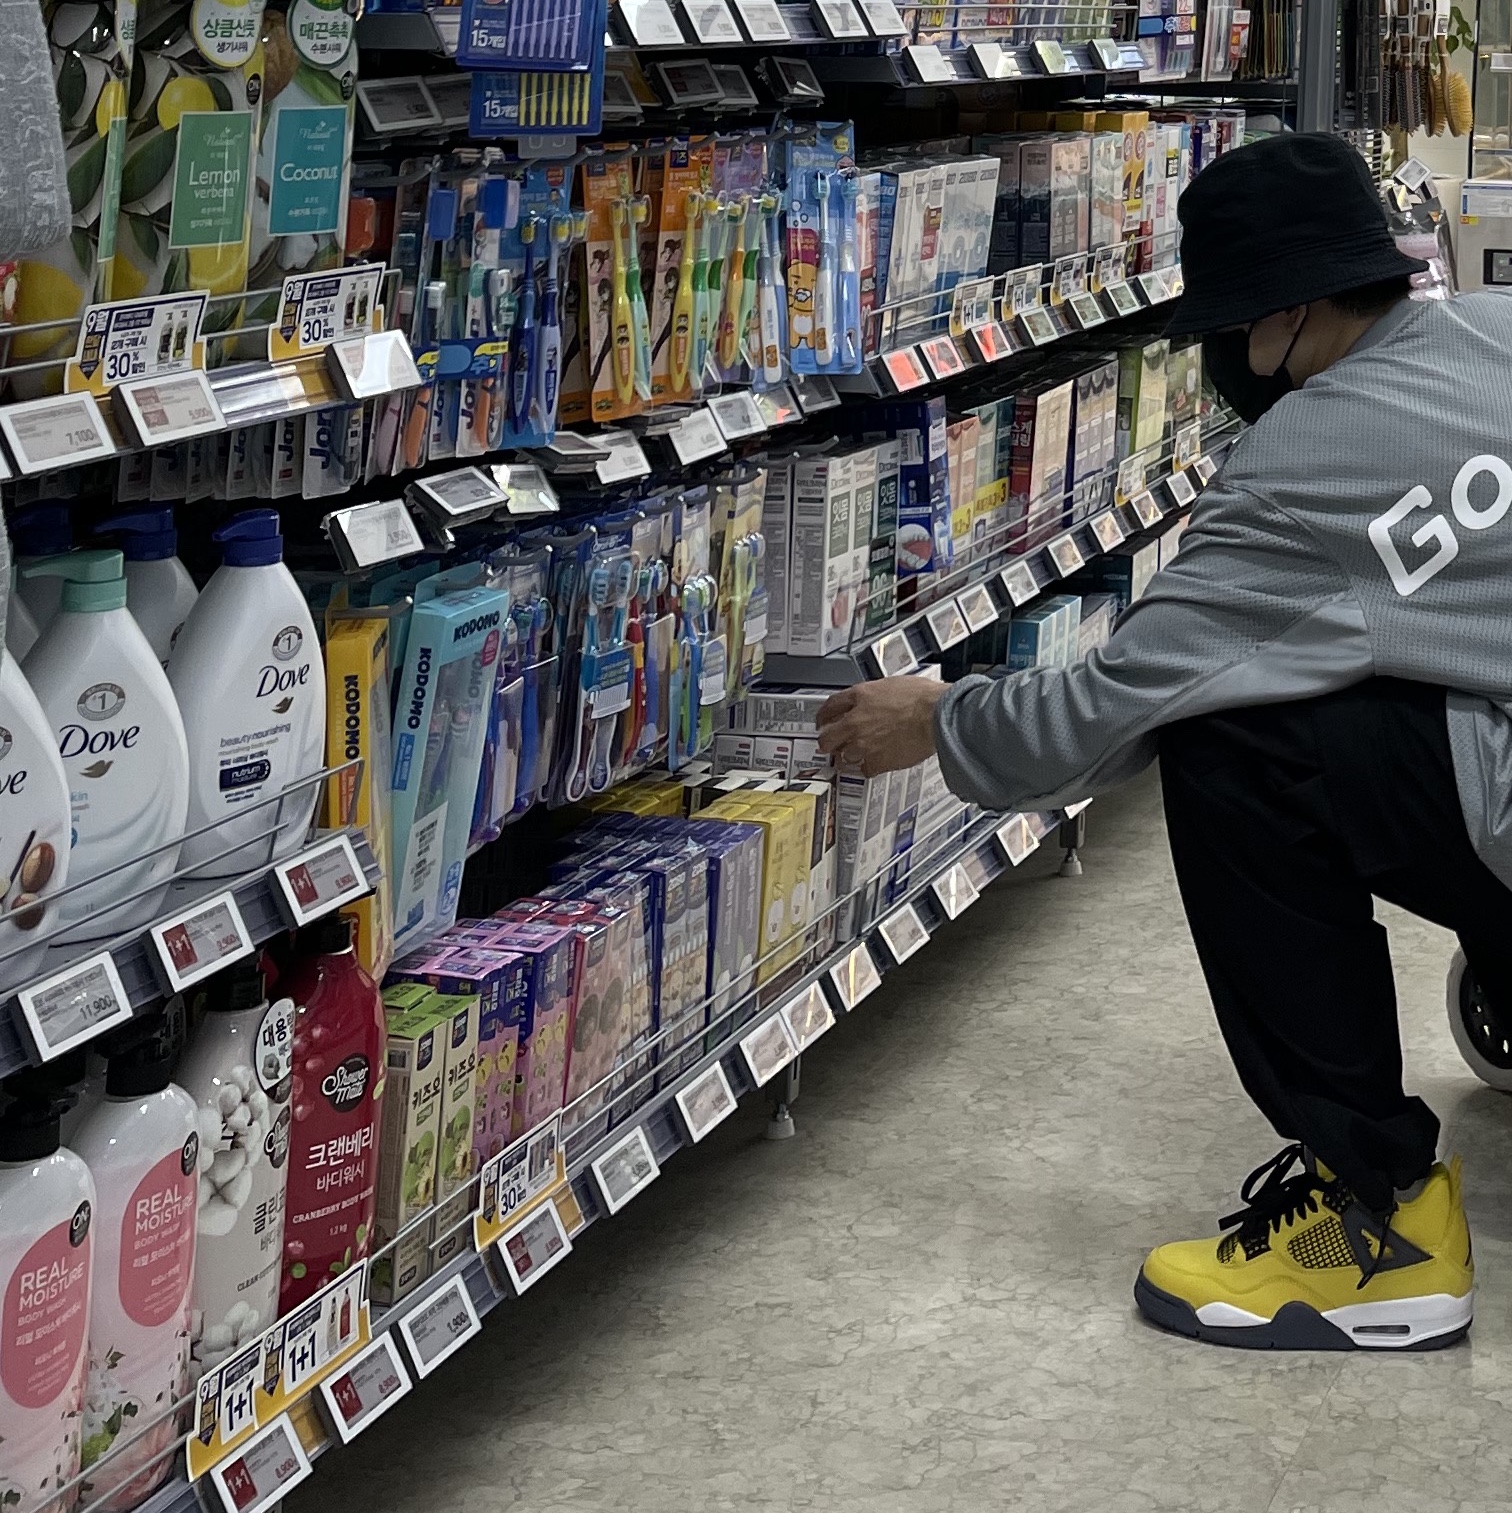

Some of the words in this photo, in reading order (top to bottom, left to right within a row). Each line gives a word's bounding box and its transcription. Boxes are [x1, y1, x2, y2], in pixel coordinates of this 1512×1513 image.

[202, 17, 256, 39] 상큼산뜻
[299, 21, 349, 40] 매끈촉촉
[471, 29, 507, 48] 15개입
[215, 40, 249, 54] 생기샤워
[310, 42, 341, 55] 수분샤워
[483, 99, 519, 118] 15개입
[188, 161, 240, 186] Lemon
[280, 162, 339, 182] Coconut
[284, 280, 303, 301] 9월
[86, 310, 107, 333] 9월
[302, 318, 322, 344] 30
[106, 352, 130, 380] 30
[131, 360, 147, 374] 할인
[453, 610, 501, 643] KODOMO
[256, 663, 310, 699] Dove
[407, 647, 432, 730] KODOMO
[344, 674, 360, 760] KODOMO
[59, 724, 141, 759] Dove
[290, 871, 314, 896] 1+1
[168, 933, 191, 956] 1+1
[321, 1065, 369, 1099] Shower
[412, 1071, 442, 1110] 키즈오
[305, 1122, 375, 1170] 크랜베리
[316, 1159, 366, 1193] 바디워시
[134, 1191, 195, 1236] MOISTURE
[135, 1183, 183, 1221] REAL
[292, 1202, 341, 1225] CRANBERRY
[341, 1195, 359, 1210] BODY
[500, 1186, 517, 1217] 30
[133, 1233, 160, 1250] BODY
[18, 1261, 85, 1312] MOISTURE
[20, 1255, 69, 1294] REAL
[17, 1310, 45, 1327] BODY
[288, 1329, 316, 1382] 1+1
[225, 1377, 254, 1432] 1+1
[334, 1381, 354, 1407] 1+1
[226, 1468, 252, 1496] 1+1
